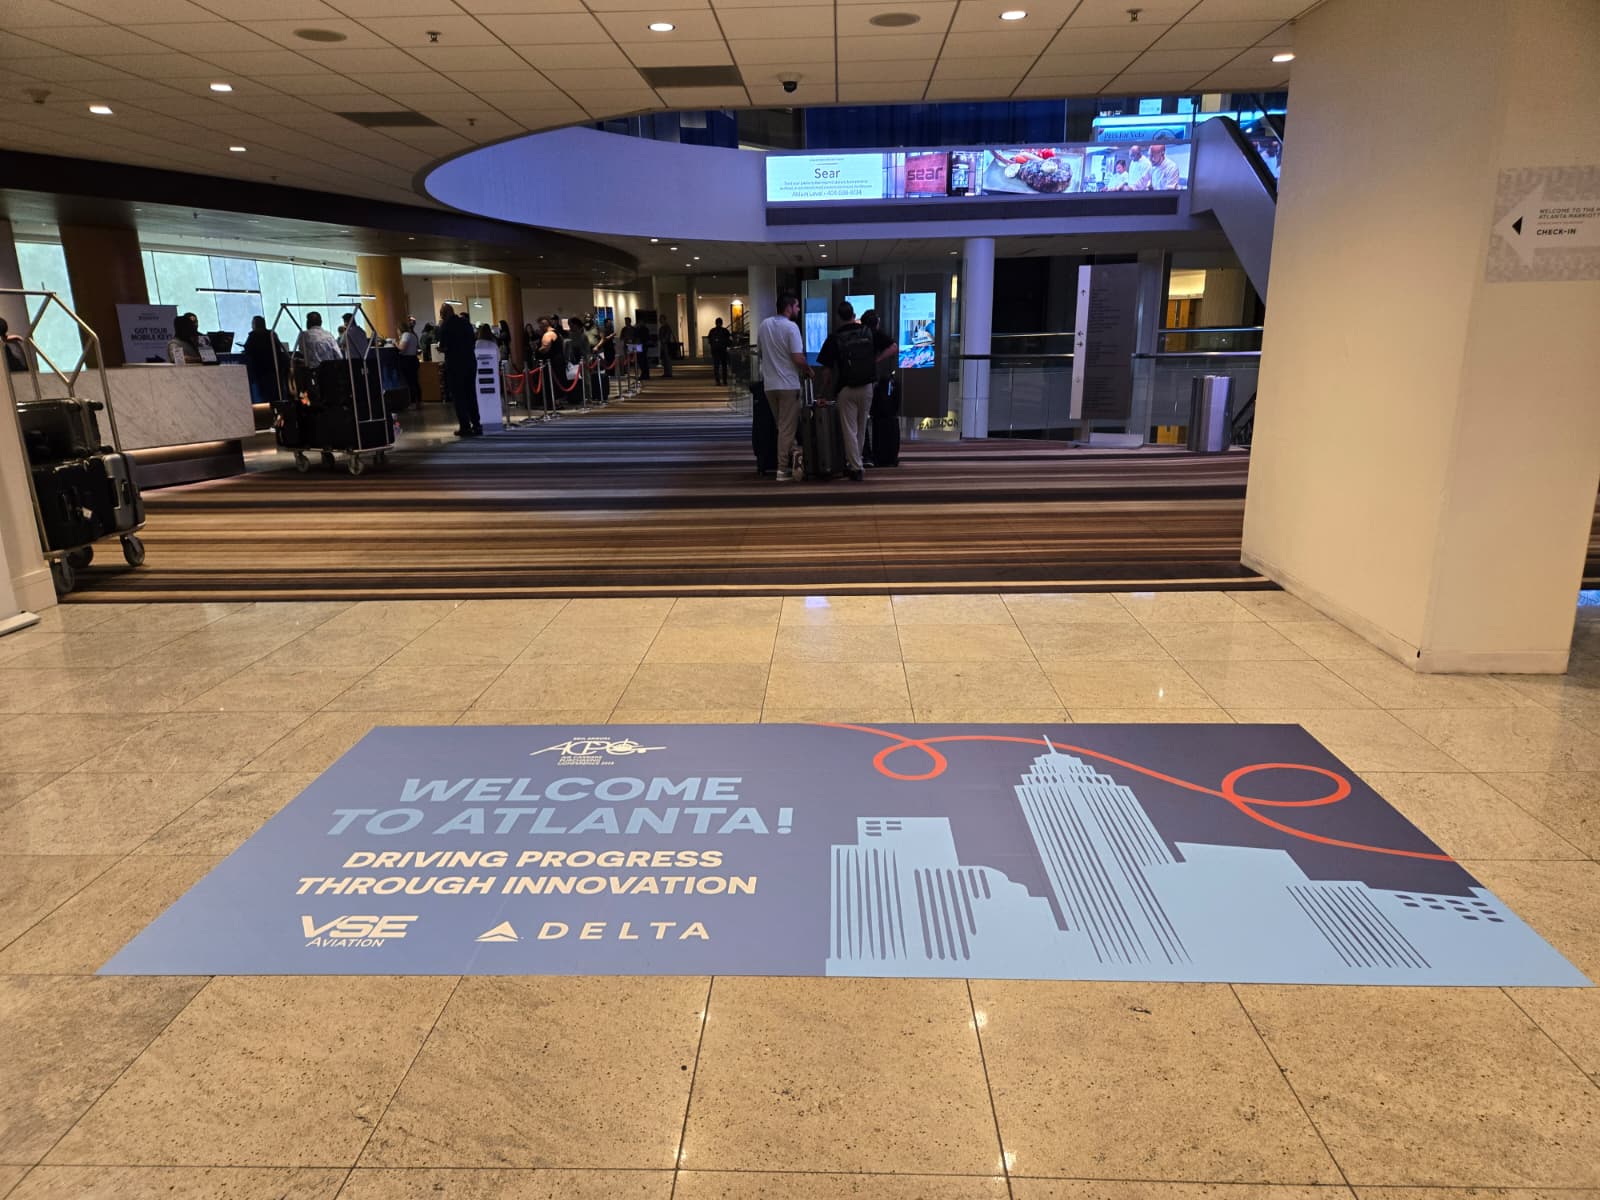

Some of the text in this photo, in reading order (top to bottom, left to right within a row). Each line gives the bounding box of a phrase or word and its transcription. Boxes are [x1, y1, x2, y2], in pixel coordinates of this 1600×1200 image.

[814, 168, 841, 179] Sear
[907, 167, 944, 181] sear
[1536, 228, 1577, 236] CHECK-IN
[400, 777, 742, 801] WELCOME
[327, 807, 794, 835] TO ATLANTA!
[342, 850, 723, 868] DRIVING PROGRESS
[296, 876, 758, 895] THROUGH INNOVATION
[301, 915, 419, 938] VSE
[537, 921, 710, 940] DELTA
